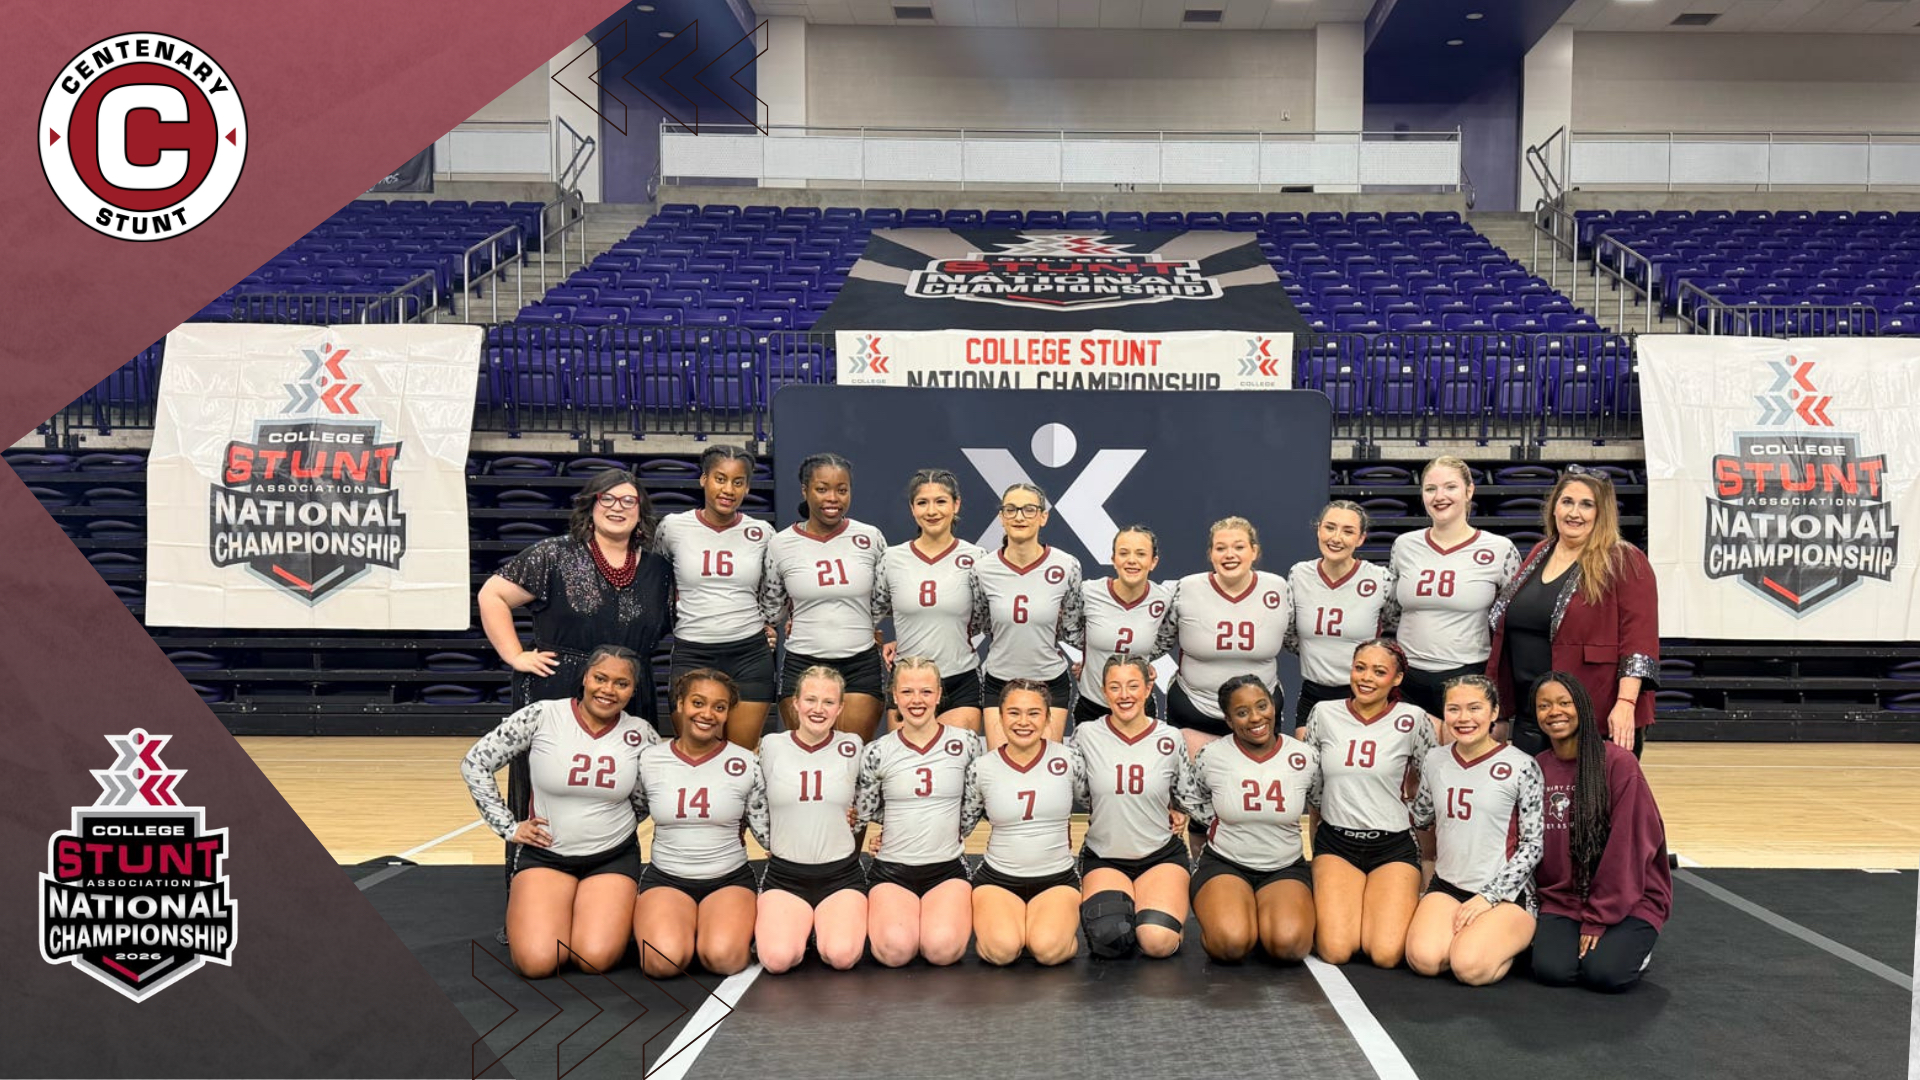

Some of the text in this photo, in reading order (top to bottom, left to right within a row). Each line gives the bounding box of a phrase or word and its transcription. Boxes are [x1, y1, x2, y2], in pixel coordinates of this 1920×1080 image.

[927, 274, 1201, 285] NATIONAL
[944, 261, 1182, 274] STUNT
[922, 283, 1206, 296] CHAMPIONSHIP
[966, 338, 1161, 367] COLLEGE STUNT
[907, 370, 1220, 391] NATIONAL CHAMPIONSHIP
[268, 430, 364, 444] COLLEGE
[1750, 444, 1846, 456] COLLEGE
[226, 446, 397, 484] STUNT
[1716, 458, 1883, 497] STUNT
[255, 484, 364, 494] ASSOCIATION
[1747, 498, 1856, 506] ASSOCIATION
[215, 491, 401, 527] NATIONAL
[1711, 505, 1894, 539] NATIONAL
[215, 531, 401, 563] CHAMPIONSHIP
[1709, 544, 1893, 575] CHAMPIONSHIP
[701, 550, 733, 576] 16
[816, 558, 849, 586] 21
[918, 580, 937, 607] 8
[1416, 569, 1455, 597] 28
[1013, 595, 1028, 624] 6
[1314, 607, 1342, 637] 12
[1115, 628, 1133, 654] 2
[1216, 621, 1254, 650] 29
[1345, 740, 1376, 768] 19
[568, 754, 616, 789] 22
[800, 770, 822, 801] 11
[914, 768, 932, 797] 3
[1115, 764, 1144, 794] 18
[675, 787, 710, 819] 14
[1017, 790, 1036, 820] 7
[1242, 780, 1285, 813] 24
[1446, 788, 1473, 820] 15
